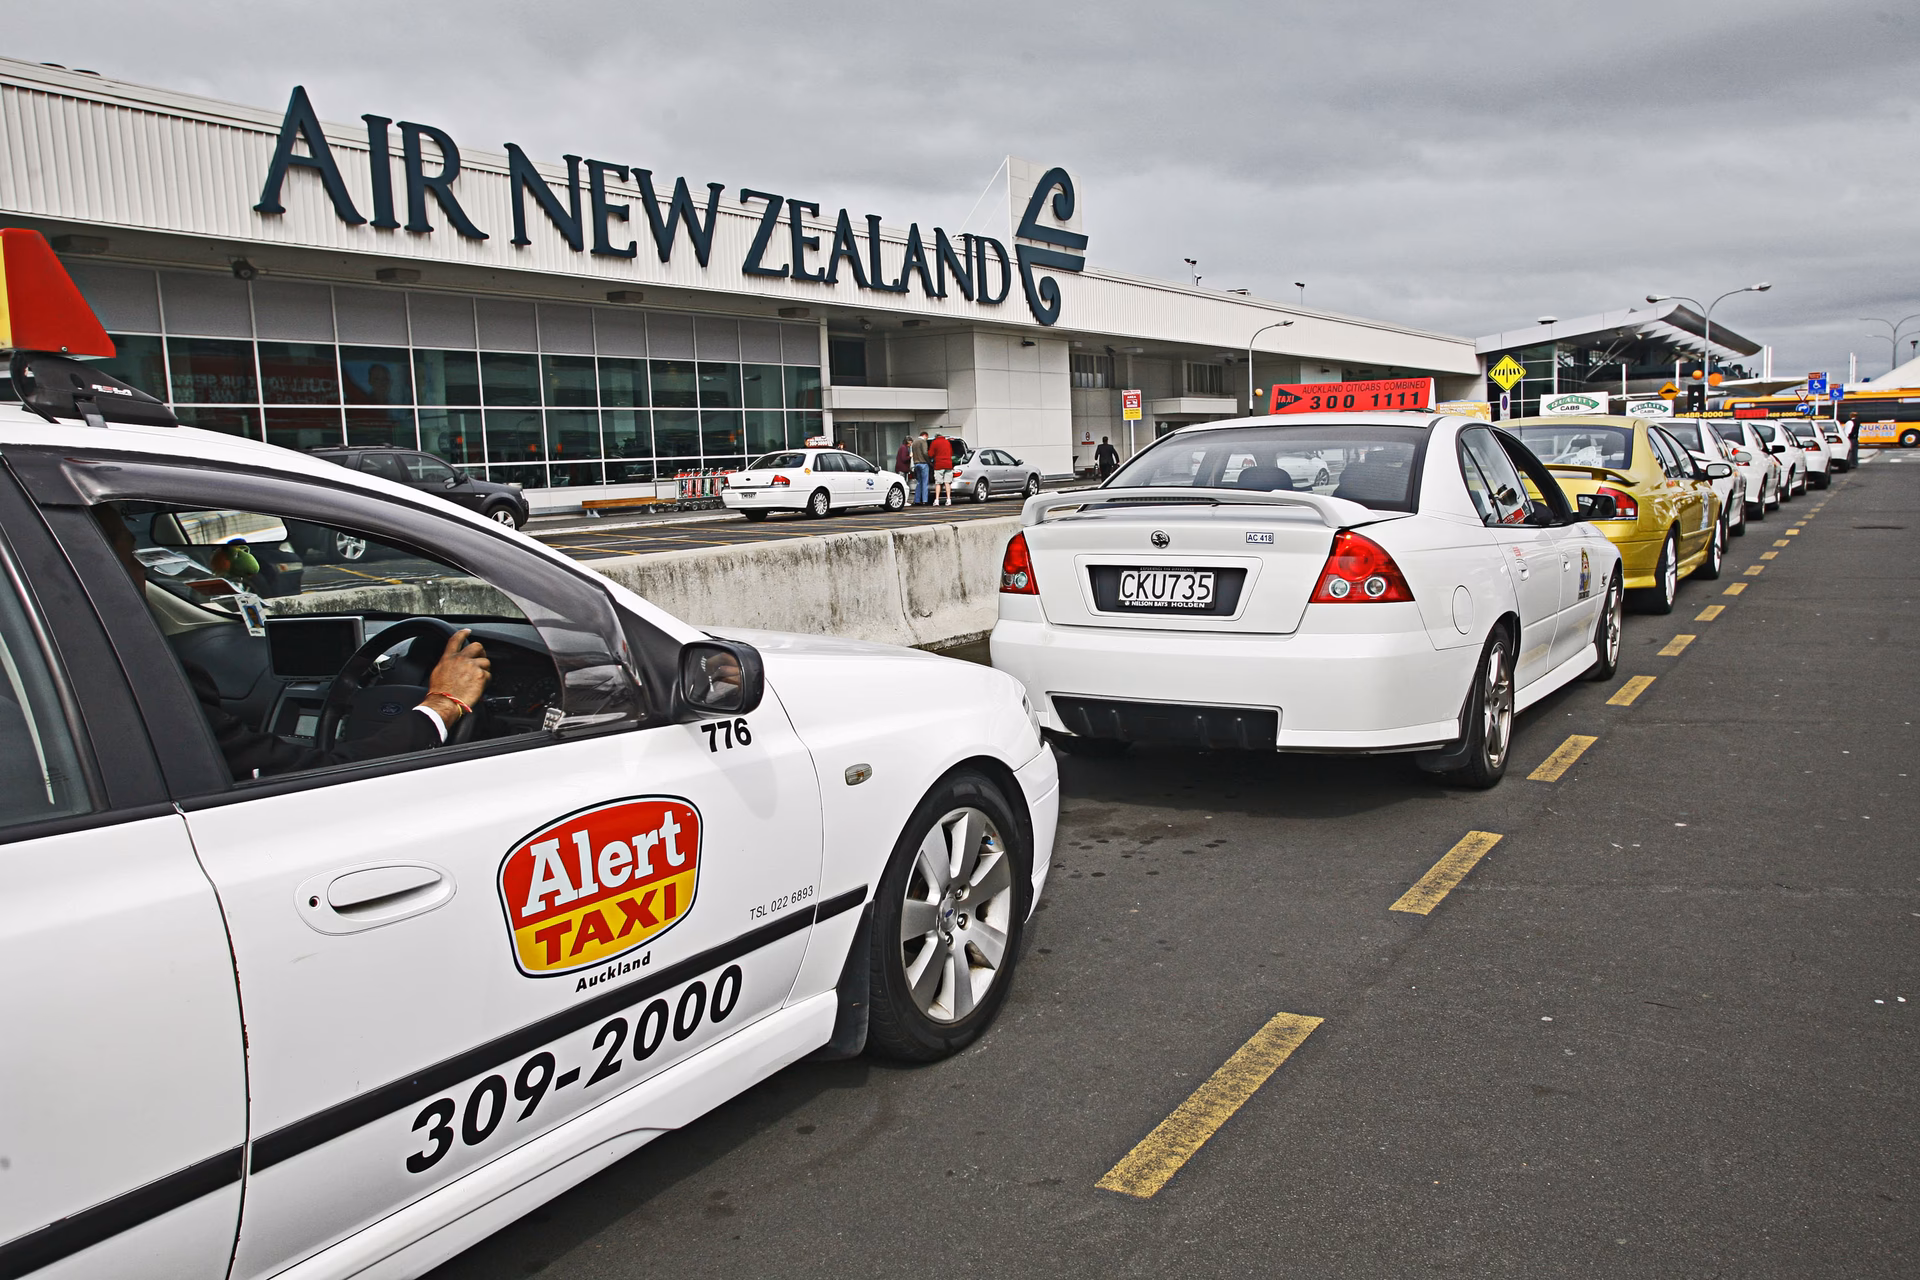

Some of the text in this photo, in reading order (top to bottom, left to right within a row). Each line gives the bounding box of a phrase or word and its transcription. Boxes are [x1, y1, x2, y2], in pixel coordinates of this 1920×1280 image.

[254, 86, 1012, 307] AIR NEW ZEALAND
[1277, 395, 1295, 403] TAXI
[1302, 380, 1426, 394] AUCKLAND CITICABS COMBINED
[1309, 391, 1419, 410] 300 1111
[1551, 395, 1595, 408] QUALITY
[1633, 402, 1669, 412] QUALITY
[1260, 534, 1273, 542] 418
[1122, 573, 1212, 600] CKU735
[701, 717, 752, 754] 776
[521, 809, 687, 918] Alert
[750, 885, 813, 920] TSL 022 6893
[534, 882, 677, 966] TAXI
[575, 951, 651, 993] Auckland
[405, 963, 744, 1175] 309-2000
